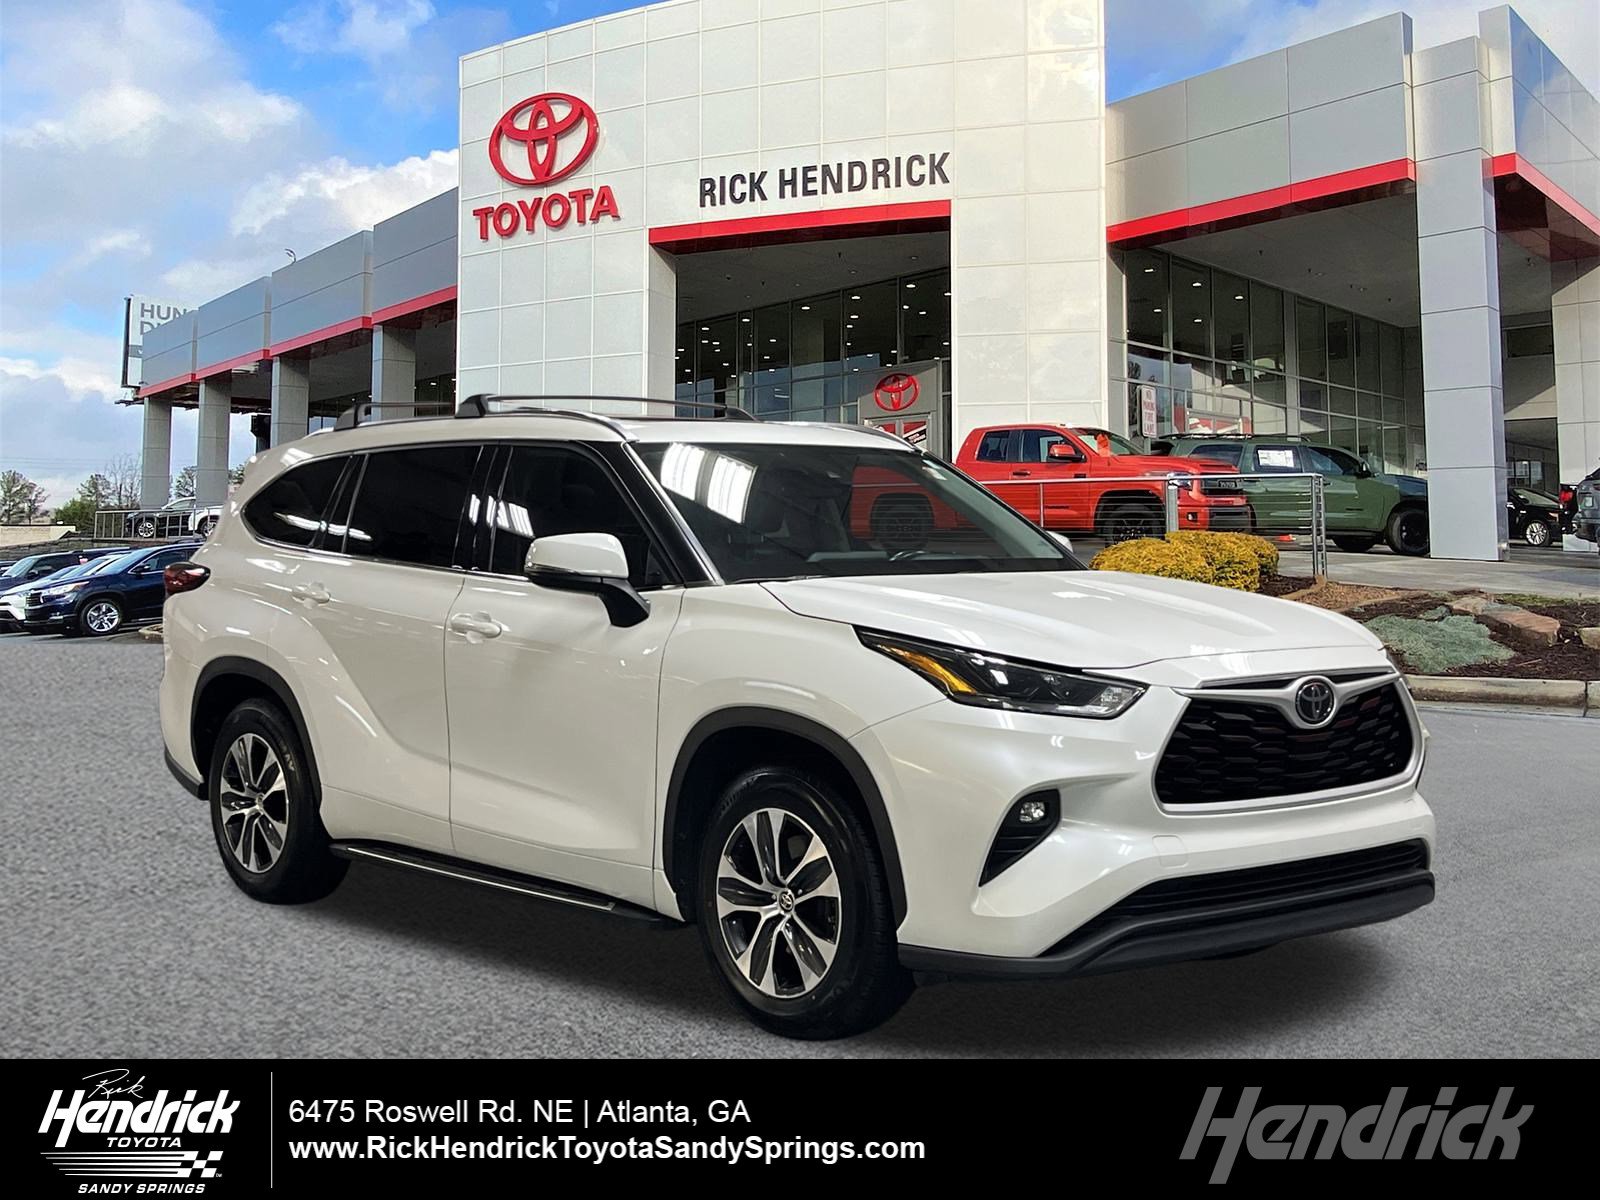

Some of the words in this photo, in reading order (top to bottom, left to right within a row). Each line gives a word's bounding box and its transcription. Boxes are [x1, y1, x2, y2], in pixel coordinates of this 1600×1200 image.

[699, 170, 768, 208] RICK
[778, 152, 950, 200] HENDRICK
[472, 184, 620, 241] TOYOTA
